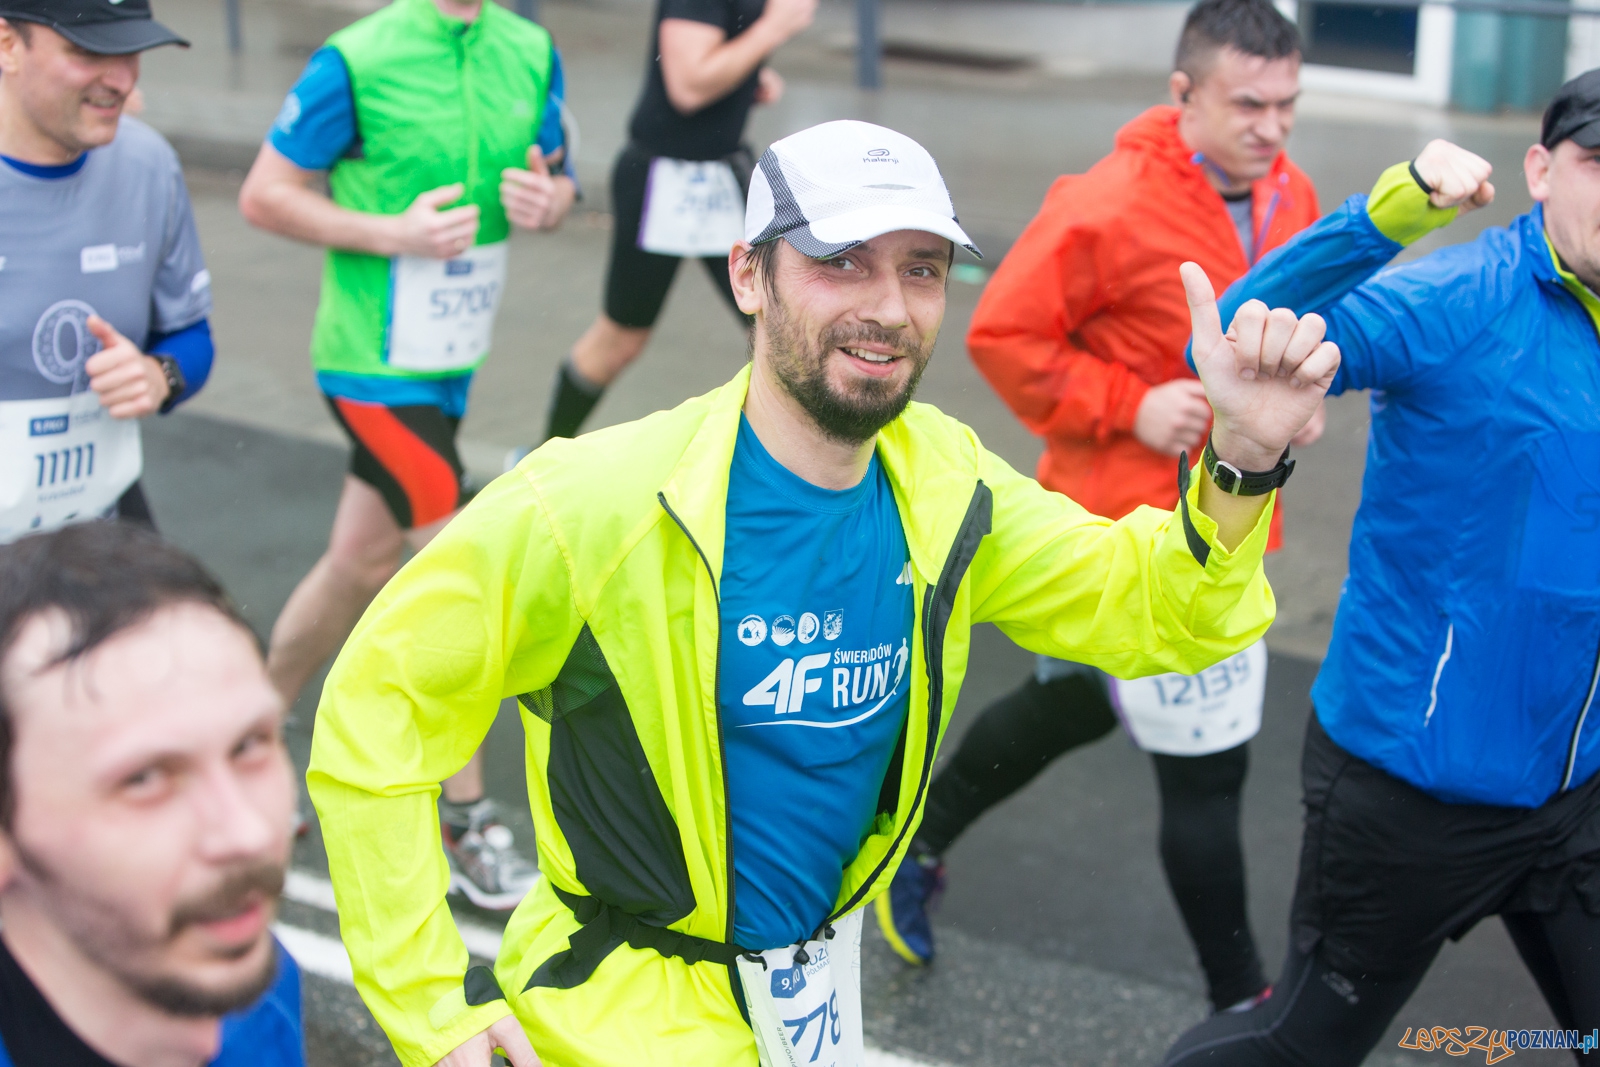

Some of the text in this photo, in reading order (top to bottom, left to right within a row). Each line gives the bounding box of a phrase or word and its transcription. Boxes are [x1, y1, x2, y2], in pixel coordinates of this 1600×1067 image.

[35, 442, 94, 487] 11111
[742, 652, 831, 714] 4F
[832, 660, 891, 708] RUN
